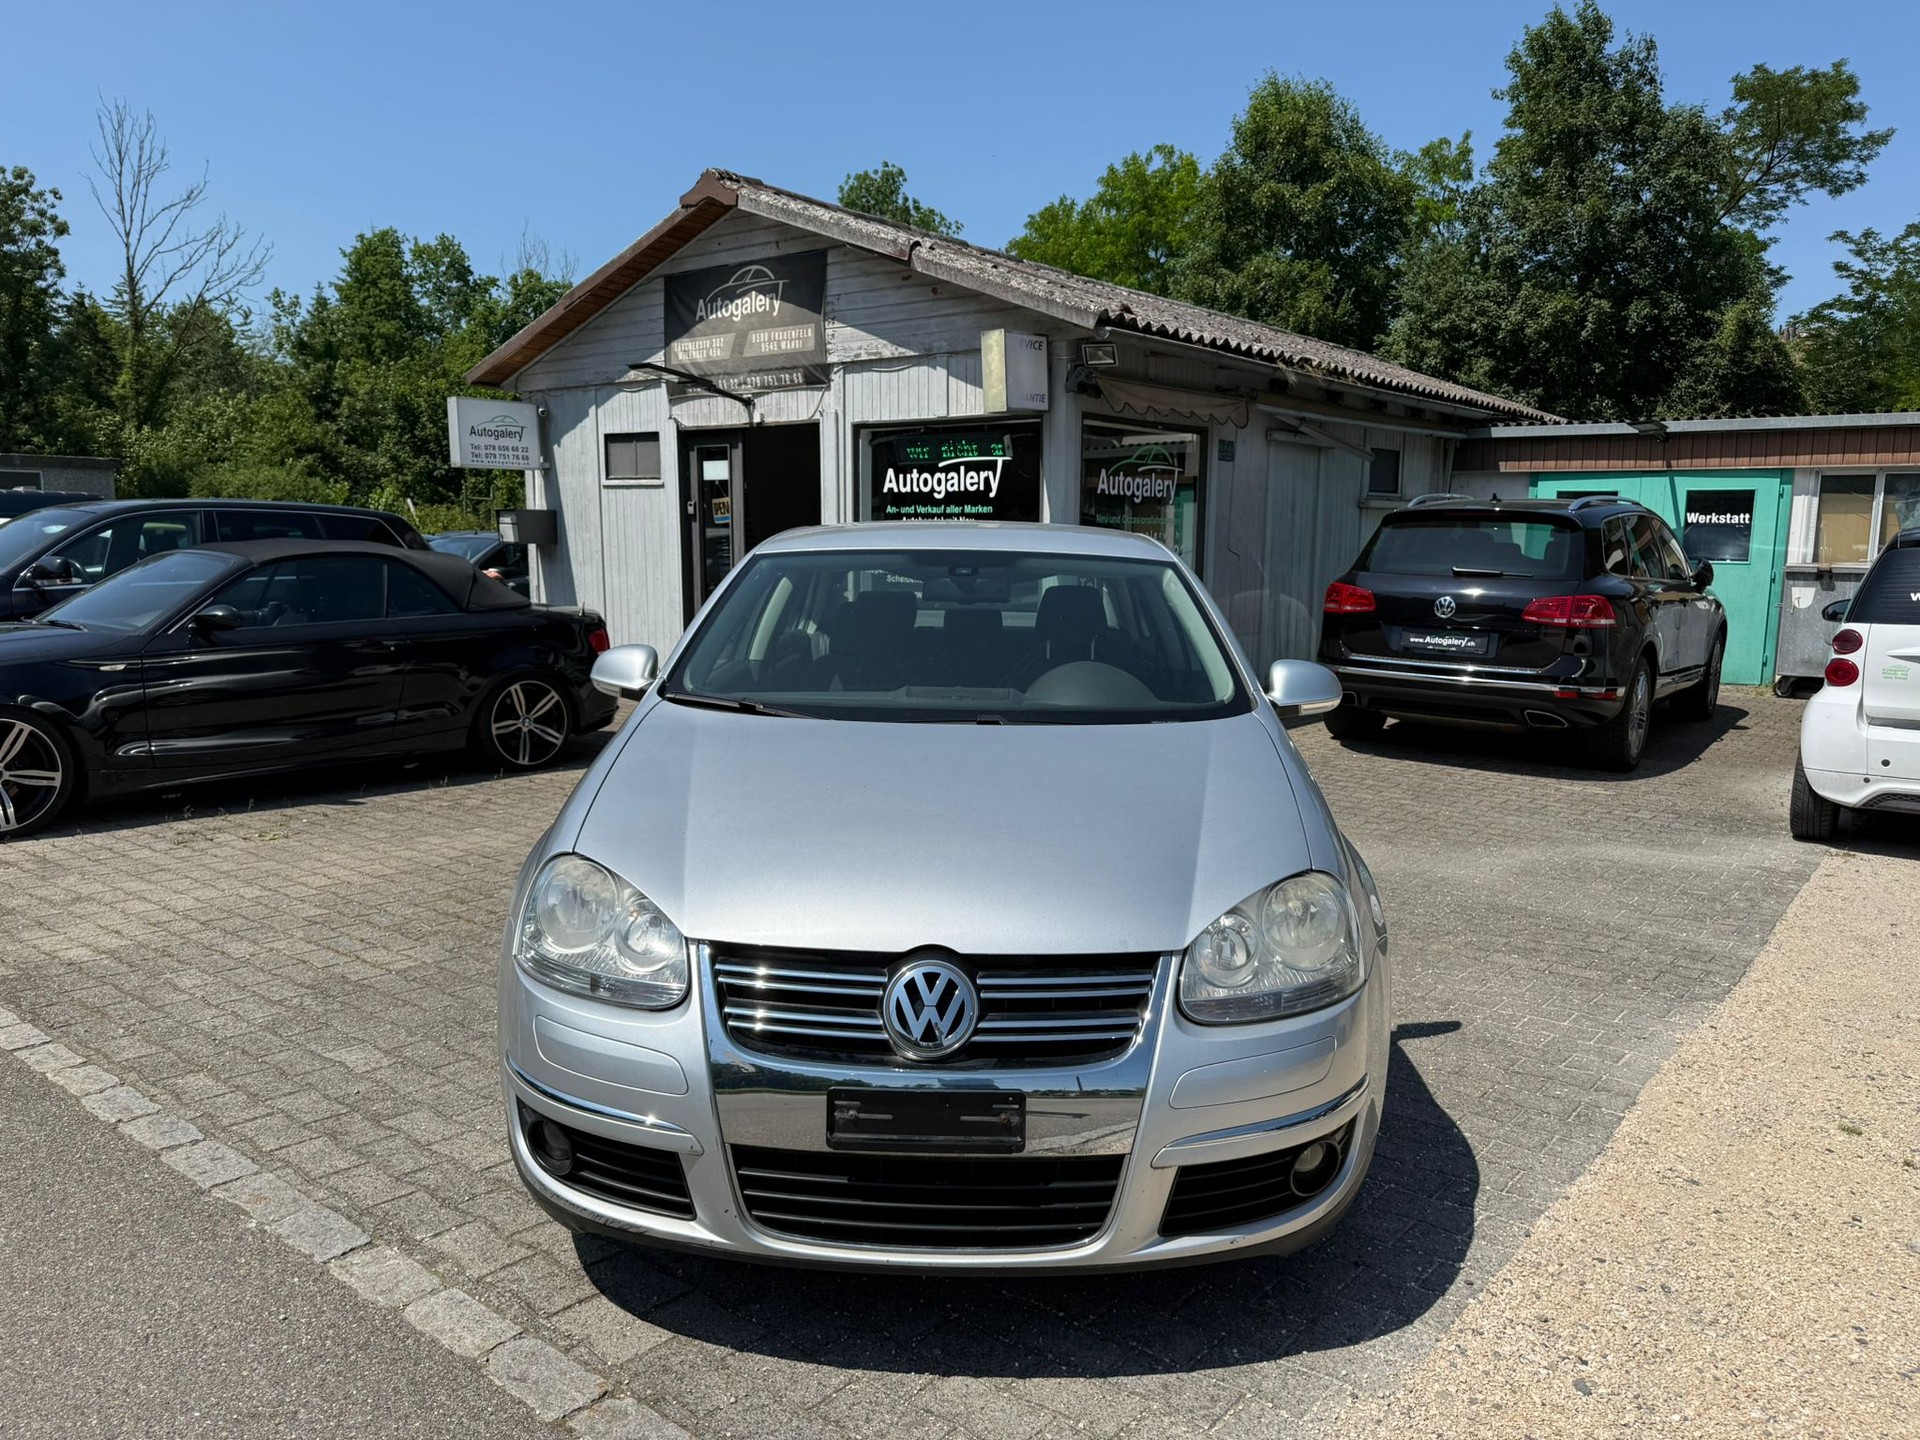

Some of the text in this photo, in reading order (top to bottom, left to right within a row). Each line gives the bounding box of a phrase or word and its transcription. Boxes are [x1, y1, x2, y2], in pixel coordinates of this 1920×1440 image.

[695, 287, 782, 322] Autogalery
[469, 425, 524, 442] Autogalery
[470, 443, 482, 451] Tel:
[471, 451, 483, 459] Tel:
[883, 459, 1003, 499] Autogalery
[1097, 468, 1178, 504] Autogalery
[885, 505, 993, 514] An- und Verkauf aller Marken
[1686, 512, 1750, 524] Werkstatt
[1409, 636, 1476, 648] www.Autogalery.ch
[886, 963, 975, 1052] VW
